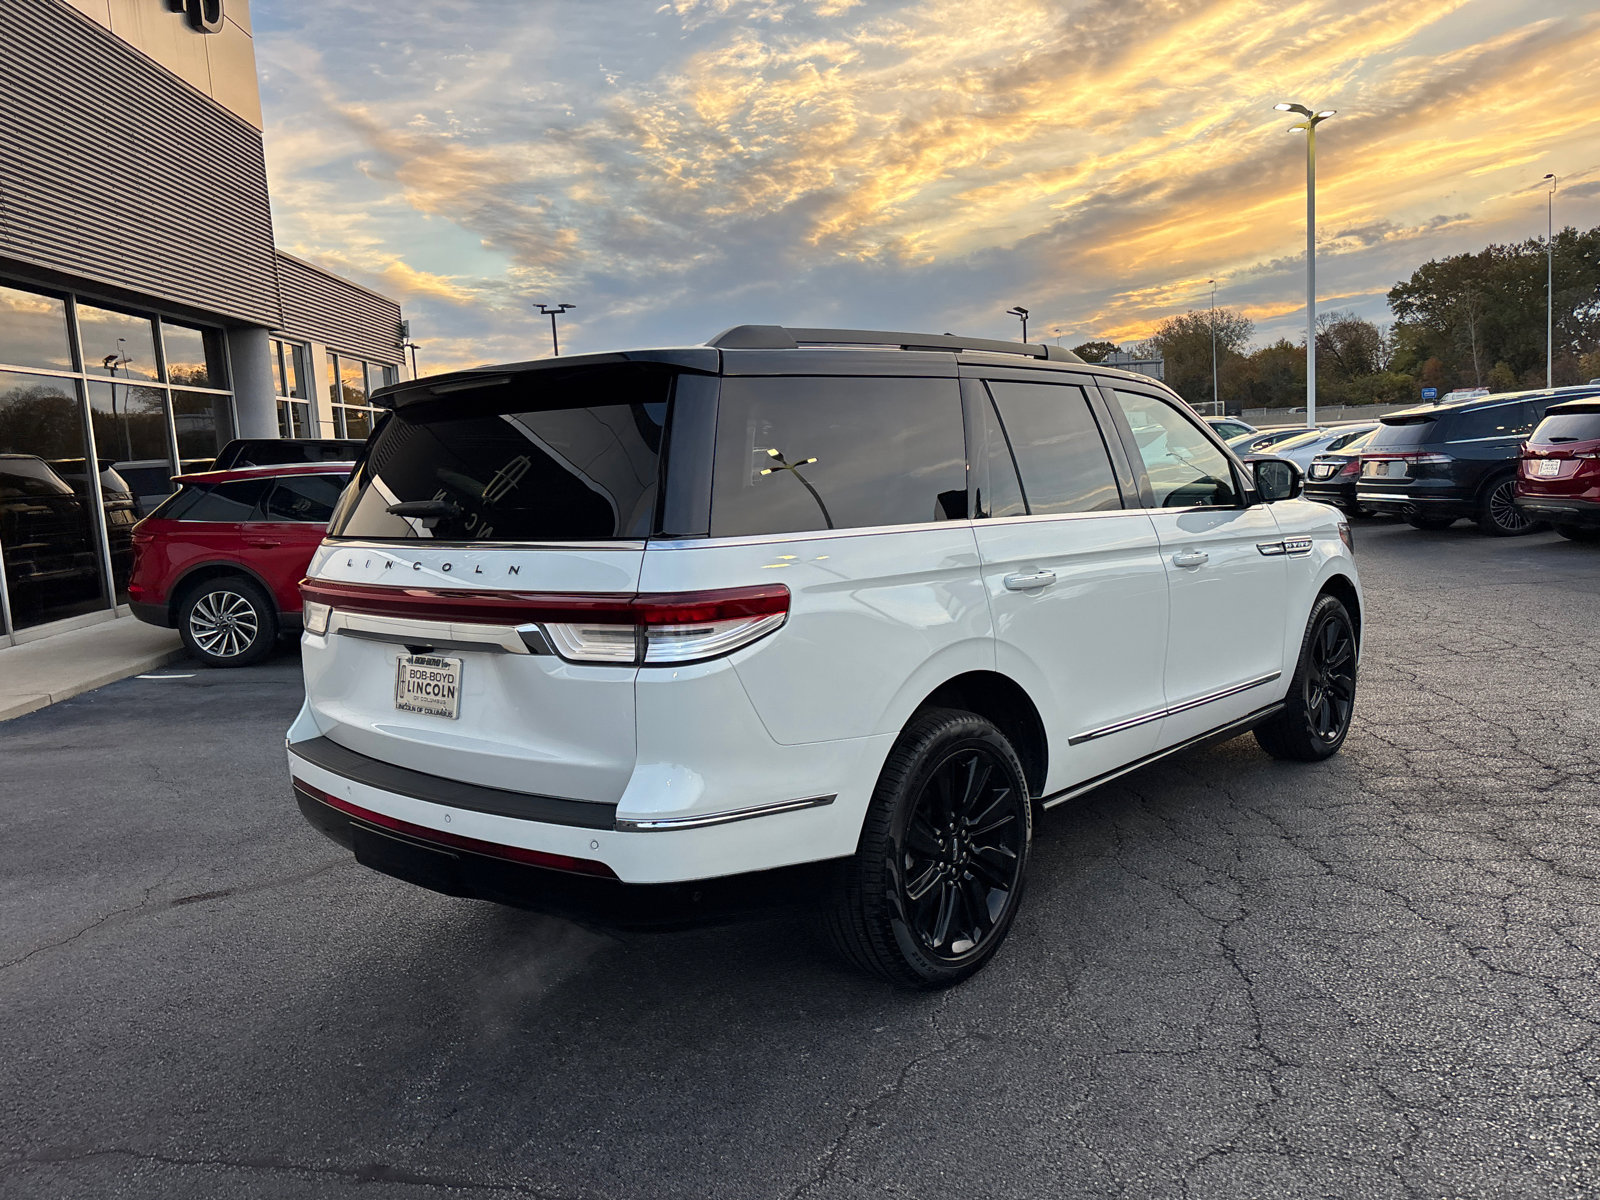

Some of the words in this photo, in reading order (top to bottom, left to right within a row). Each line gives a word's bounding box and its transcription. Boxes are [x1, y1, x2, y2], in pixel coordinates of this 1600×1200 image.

[347, 559, 521, 575] LINCOLN
[409, 669, 454, 684] BOB-BOYD
[407, 680, 455, 698] LINCOLN
